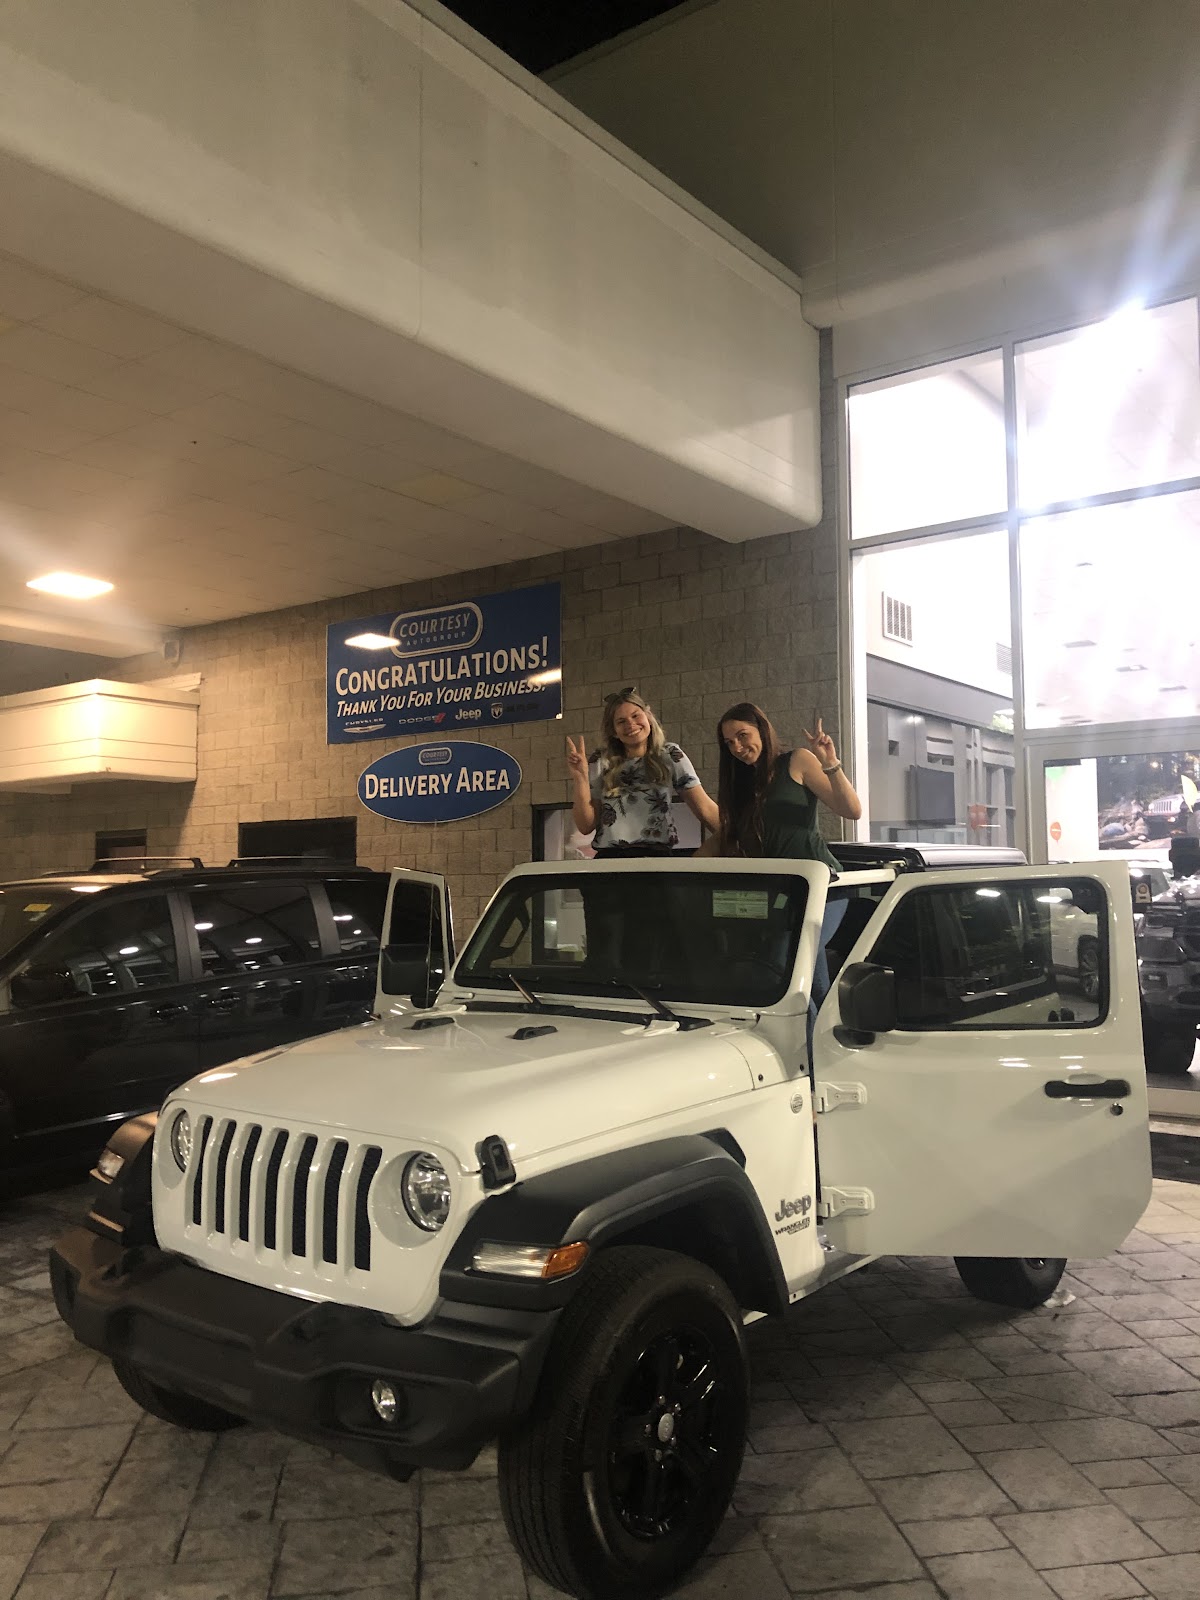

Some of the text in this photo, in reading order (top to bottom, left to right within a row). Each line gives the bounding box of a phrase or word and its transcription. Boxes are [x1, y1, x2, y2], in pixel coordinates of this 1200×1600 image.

[400, 613, 471, 638] COURTESY
[406, 631, 466, 646] AUTOGROUP
[335, 635, 548, 696] CONGRATULATIONS!
[336, 698, 378, 718] THANK
[380, 694, 406, 712] YOU
[407, 690, 433, 708] FOR
[436, 686, 473, 704] YOUR
[455, 708, 482, 721] Jeep
[365, 766, 511, 800] DELIVERY AREA
[774, 1194, 812, 1222] Jeep
[774, 1216, 811, 1236] WRANGLER
